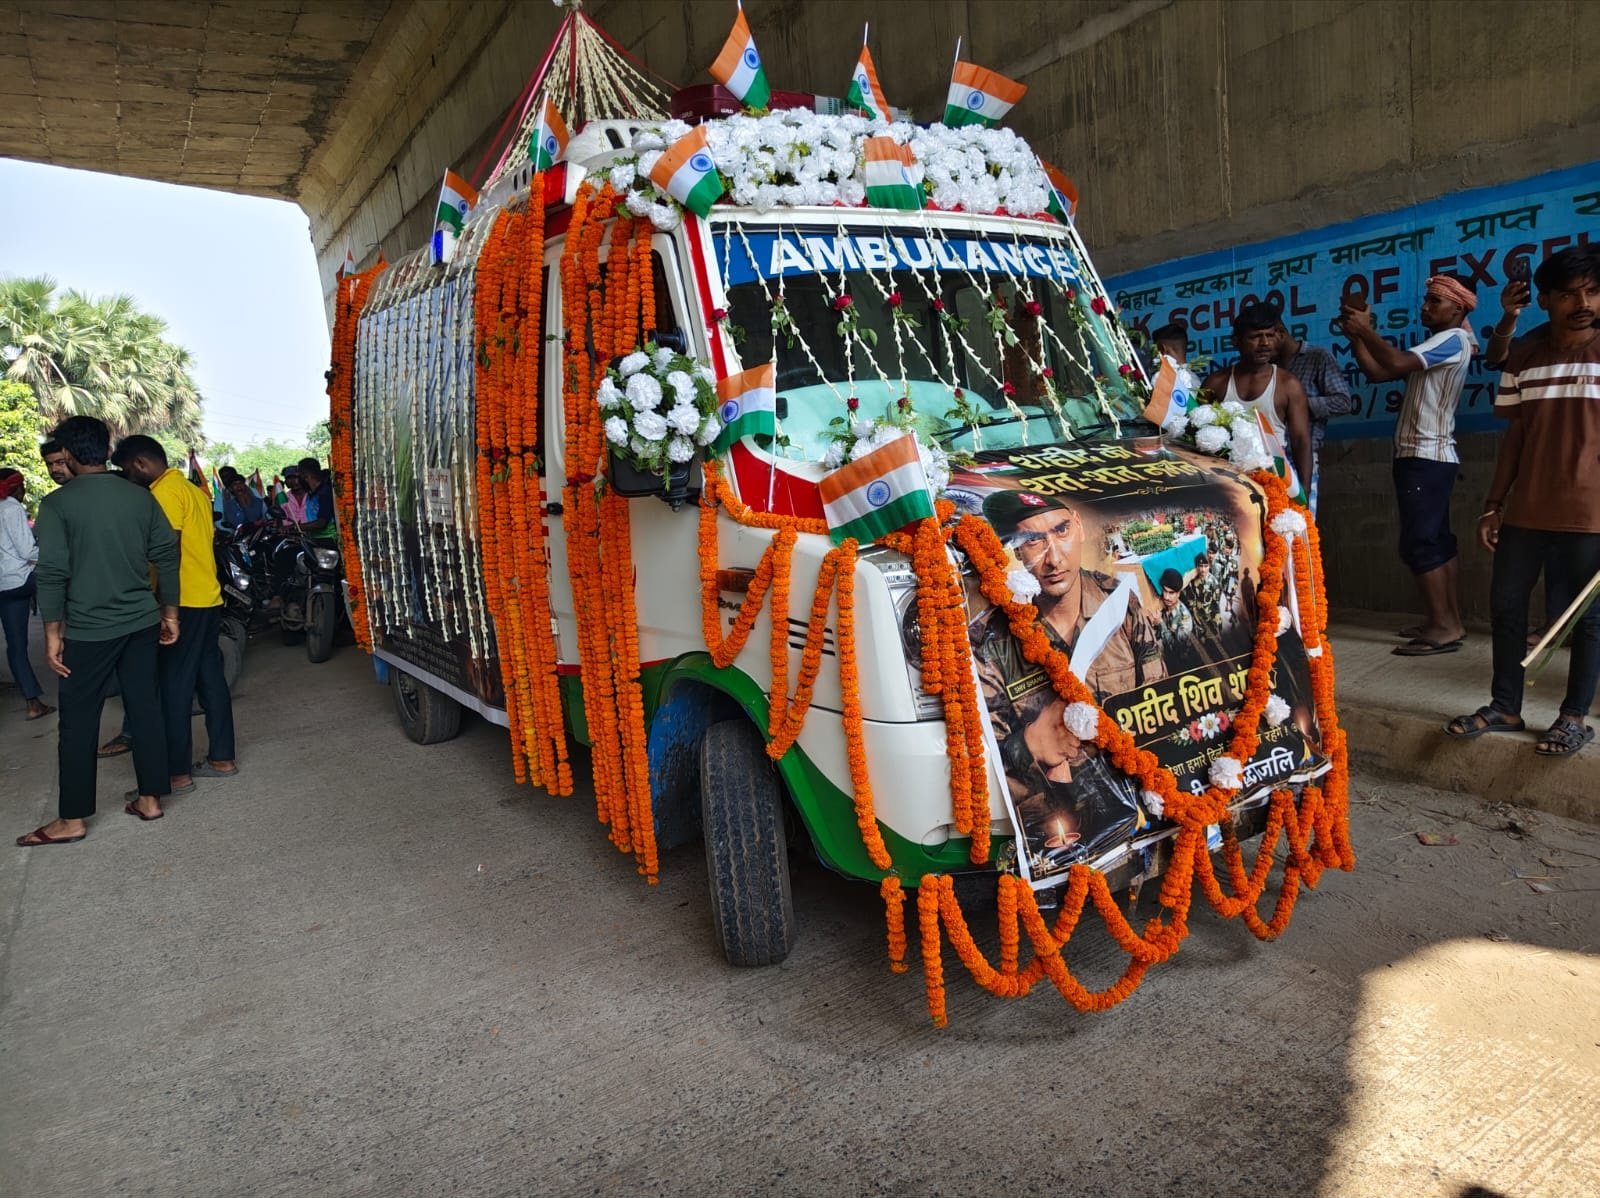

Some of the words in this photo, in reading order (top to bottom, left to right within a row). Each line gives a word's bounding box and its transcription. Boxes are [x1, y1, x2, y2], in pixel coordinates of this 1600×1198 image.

[769, 236, 1081, 280] AMBULANCE
[1115, 287, 1163, 311] बिहार
[1175, 267, 1254, 299] सरकार
[1267, 253, 1317, 285] द्वारा
[1329, 226, 1435, 265] मान्यता
[1456, 203, 1544, 243] प्राप्त
[1116, 687, 1180, 738] शहीद
[1178, 674, 1223, 718] शिव
[1186, 751, 1208, 775] हमारे
